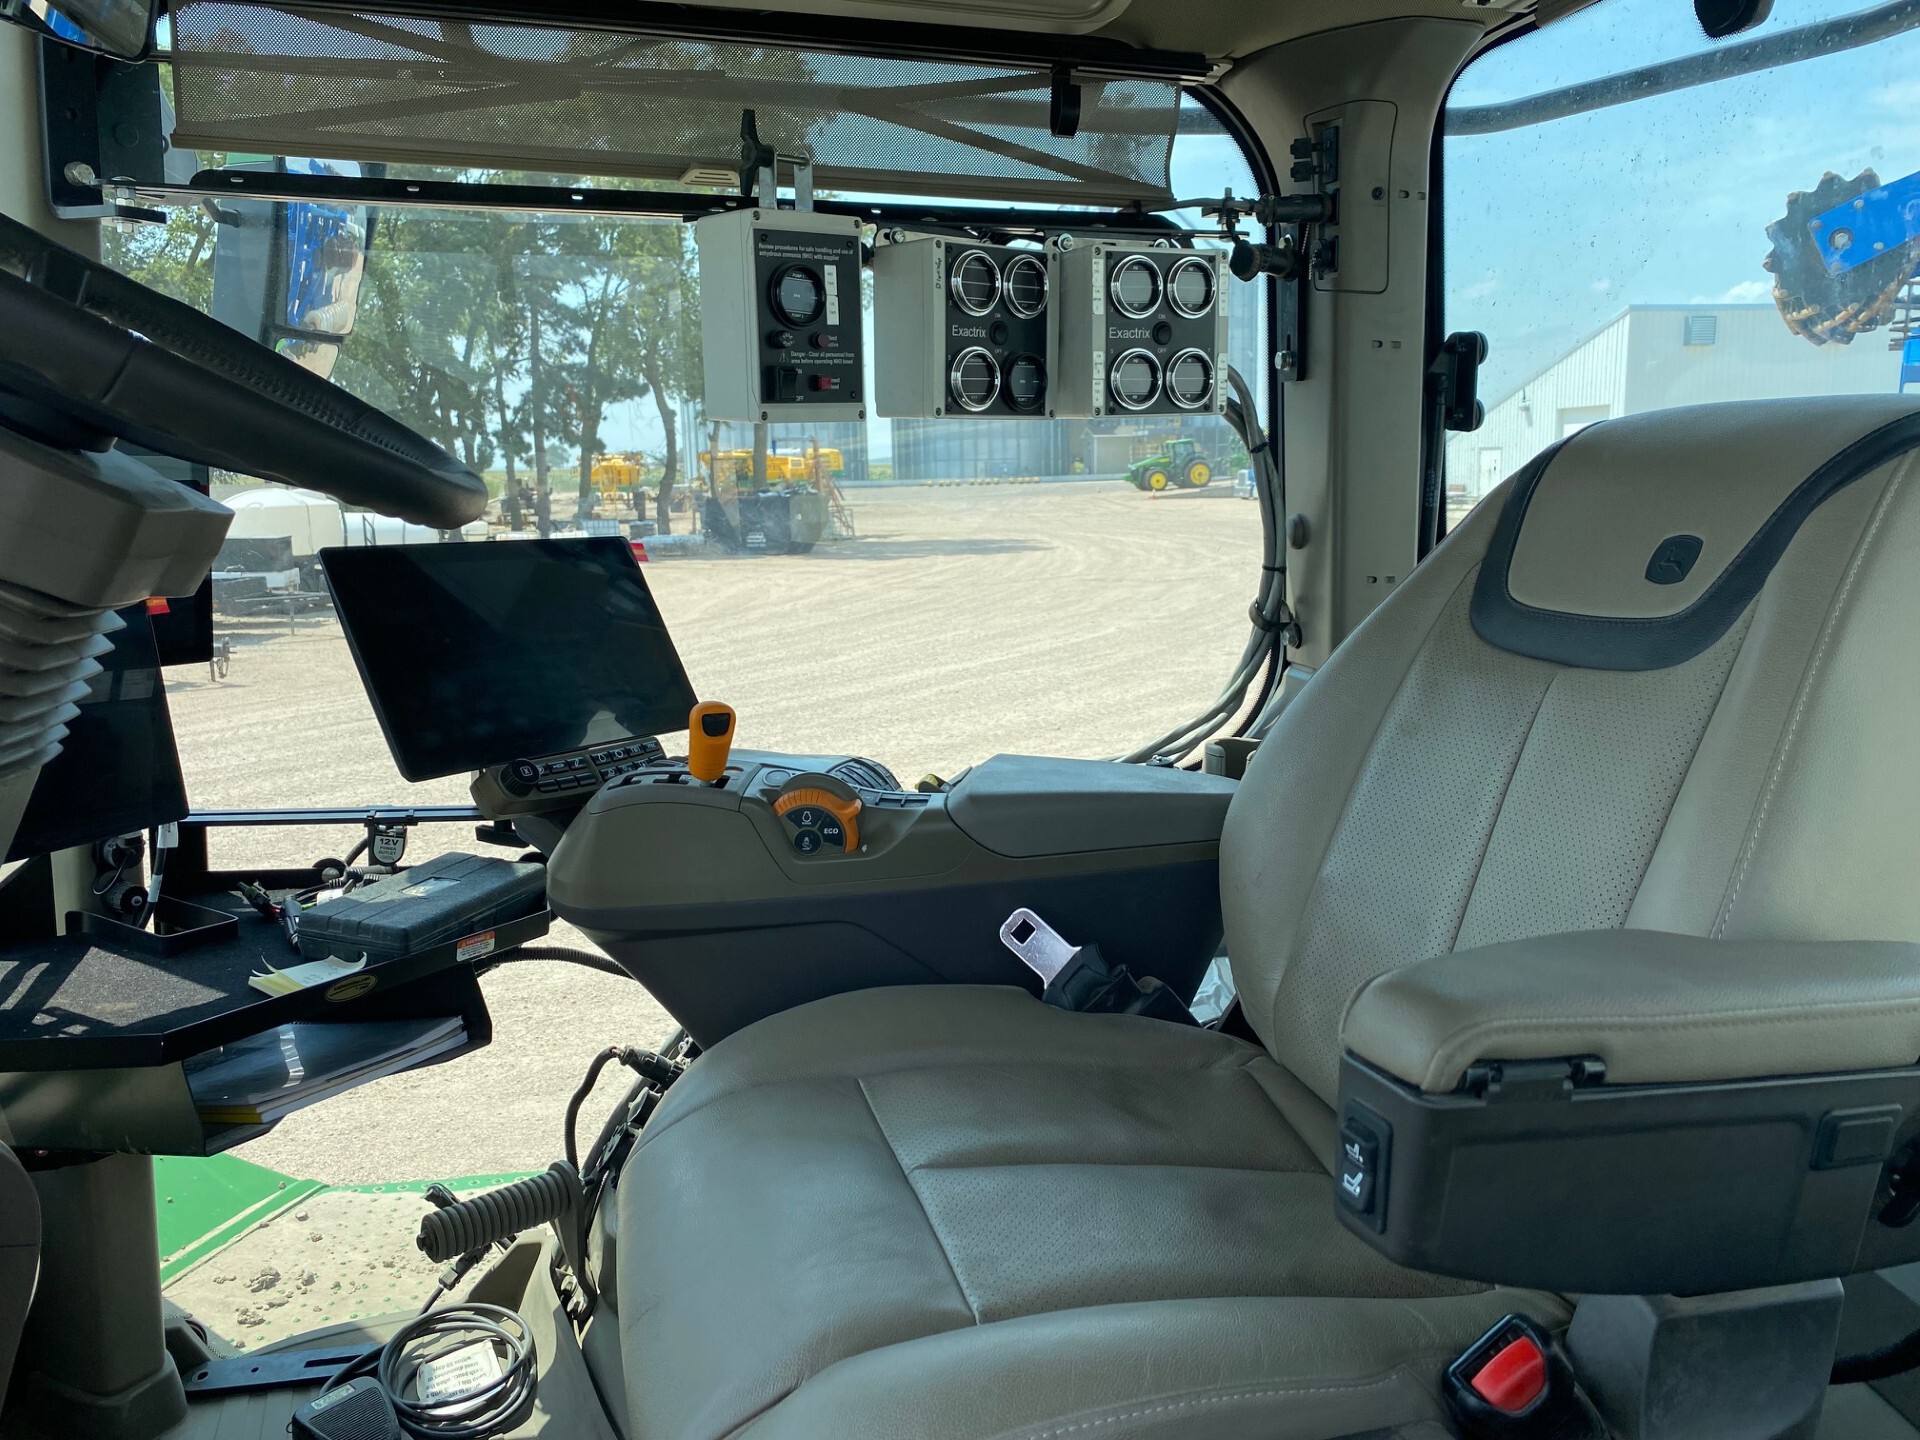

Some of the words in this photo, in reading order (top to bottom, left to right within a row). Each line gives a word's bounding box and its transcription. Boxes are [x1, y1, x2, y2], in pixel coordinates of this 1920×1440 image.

[952, 324, 987, 338] Exactrix
[1109, 327, 1151, 339] Exactrix
[790, 350, 806, 358] Danger
[379, 837, 399, 846] 12V
